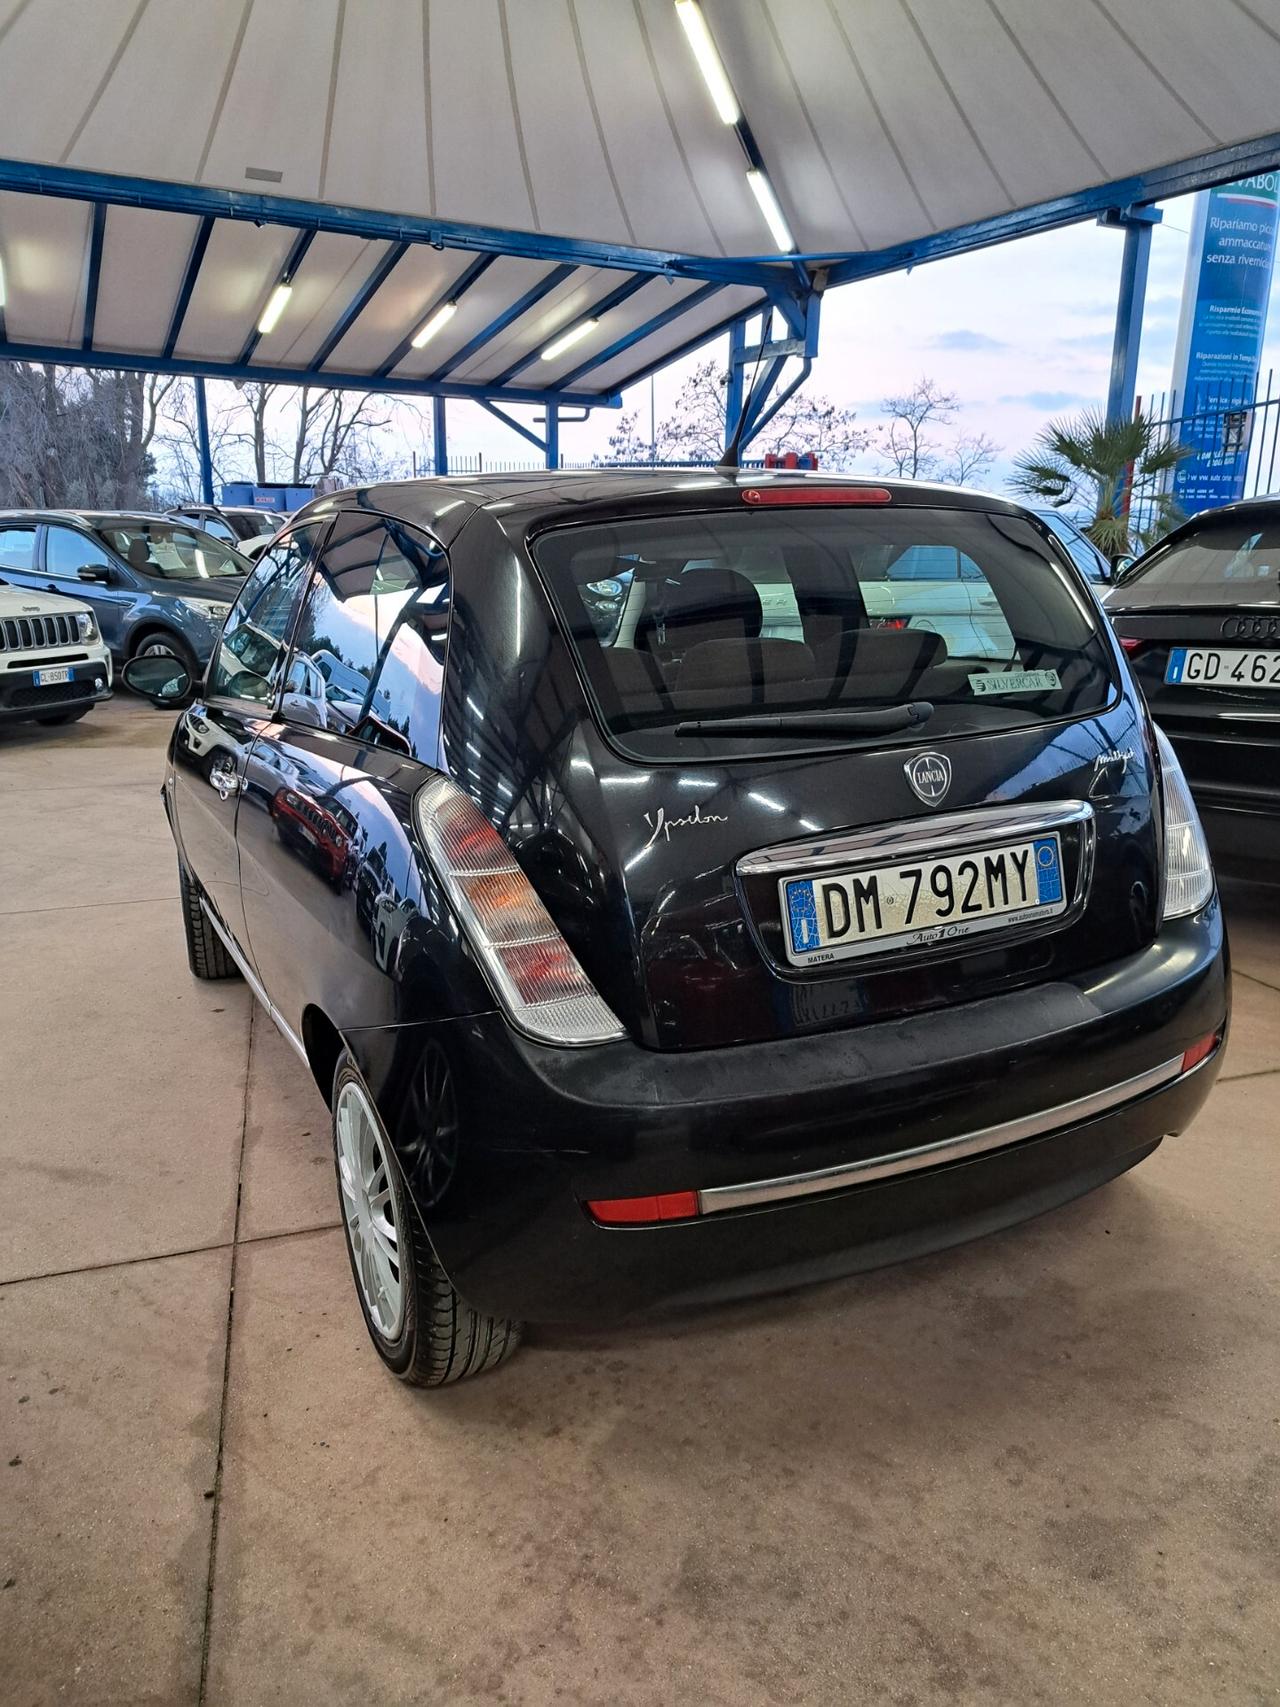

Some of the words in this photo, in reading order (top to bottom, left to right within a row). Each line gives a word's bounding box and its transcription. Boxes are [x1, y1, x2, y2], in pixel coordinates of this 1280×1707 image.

[1206, 254, 1236, 264] senza
[1187, 653, 1221, 681] GD
[916, 769, 944, 784] LANCIA
[821, 874, 883, 939] DM
[899, 848, 1030, 925] 792MY
[807, 953, 835, 964] MATERA
